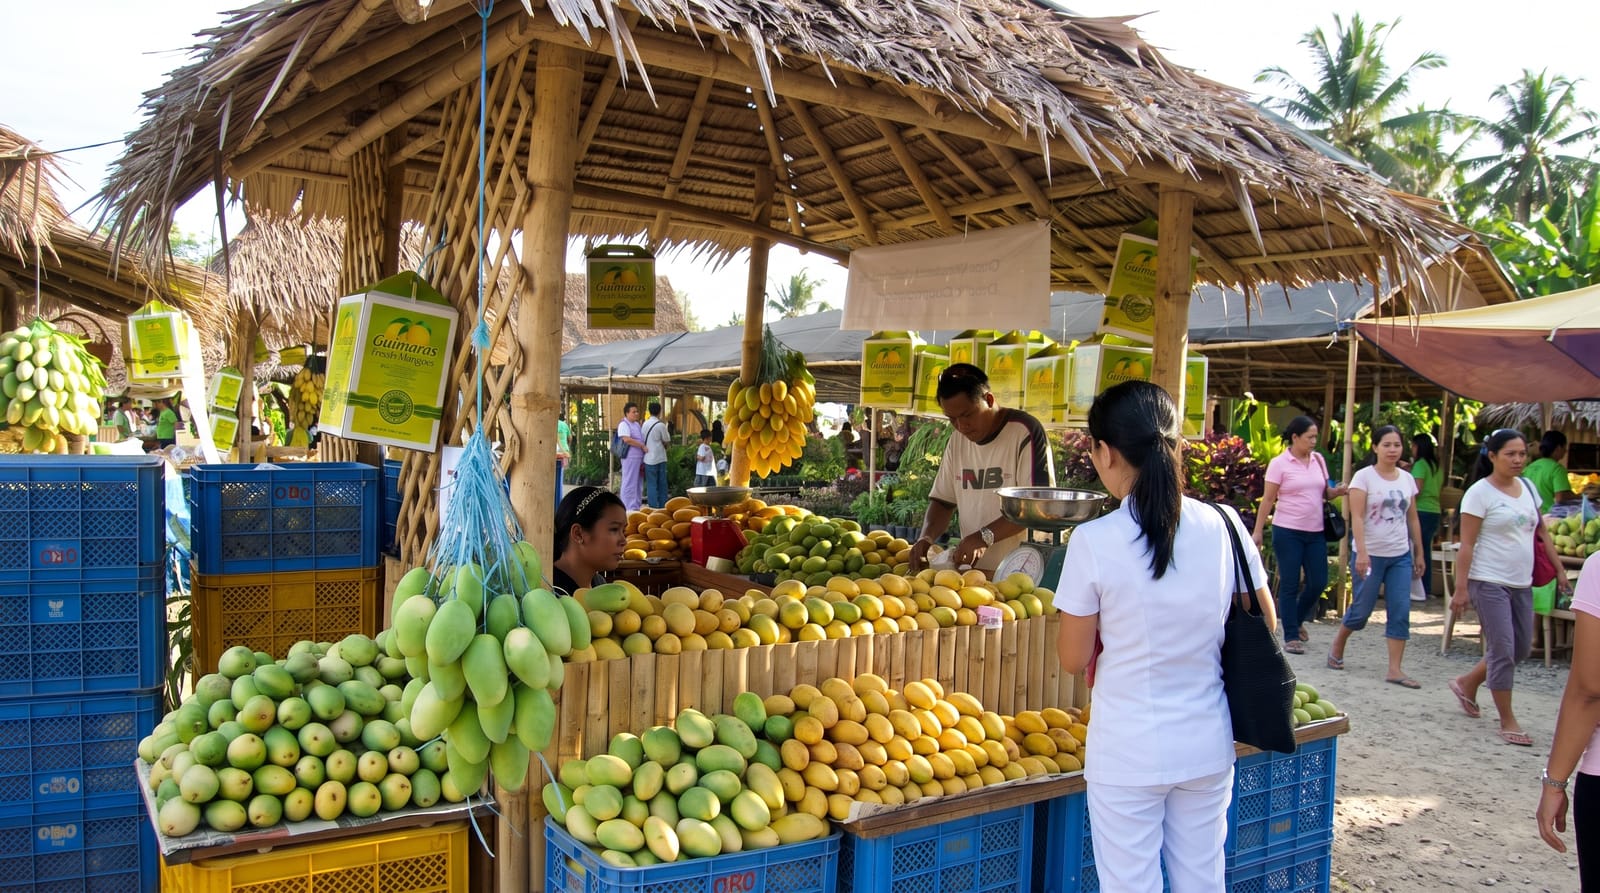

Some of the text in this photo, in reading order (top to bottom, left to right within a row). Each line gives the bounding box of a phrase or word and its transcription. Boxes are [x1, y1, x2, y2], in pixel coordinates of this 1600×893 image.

[372, 334, 439, 357] Guimaras
[399, 352, 434, 367] Mangoes
[962, 466, 1004, 490] NB
